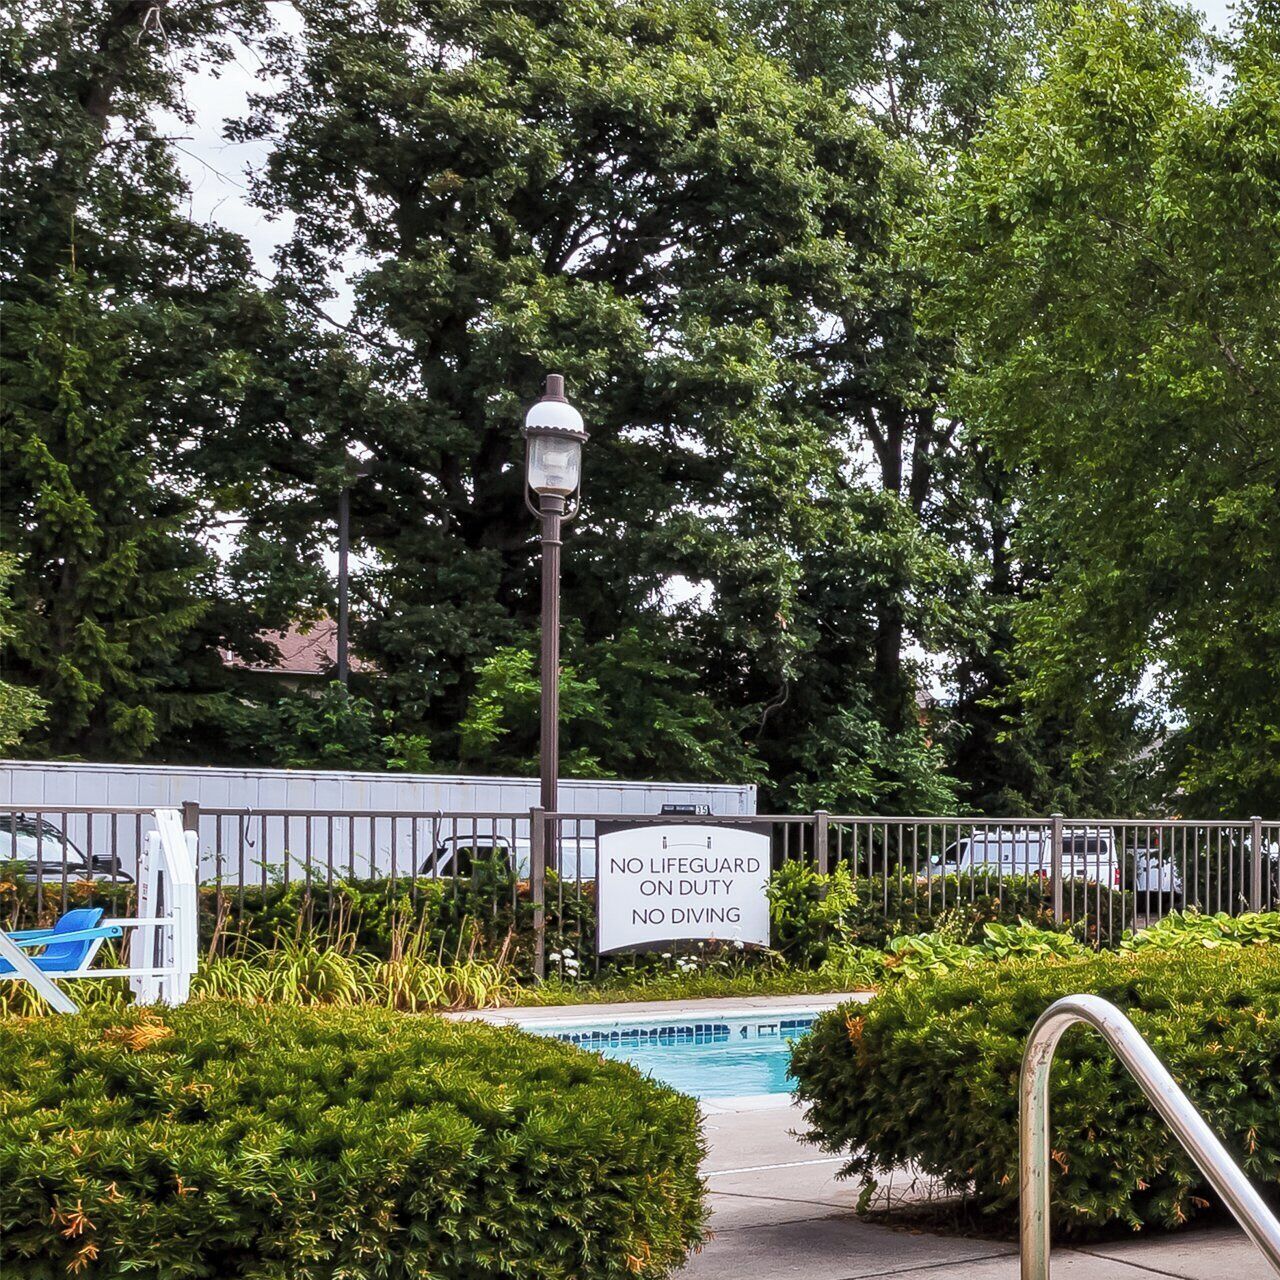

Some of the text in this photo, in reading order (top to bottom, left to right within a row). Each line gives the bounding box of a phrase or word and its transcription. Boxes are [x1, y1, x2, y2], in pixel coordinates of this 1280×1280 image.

[610, 857, 761, 874] NO LIFEGUARD
[640, 879, 734, 896] ON DUTY
[632, 907, 741, 925] NO DIVING
